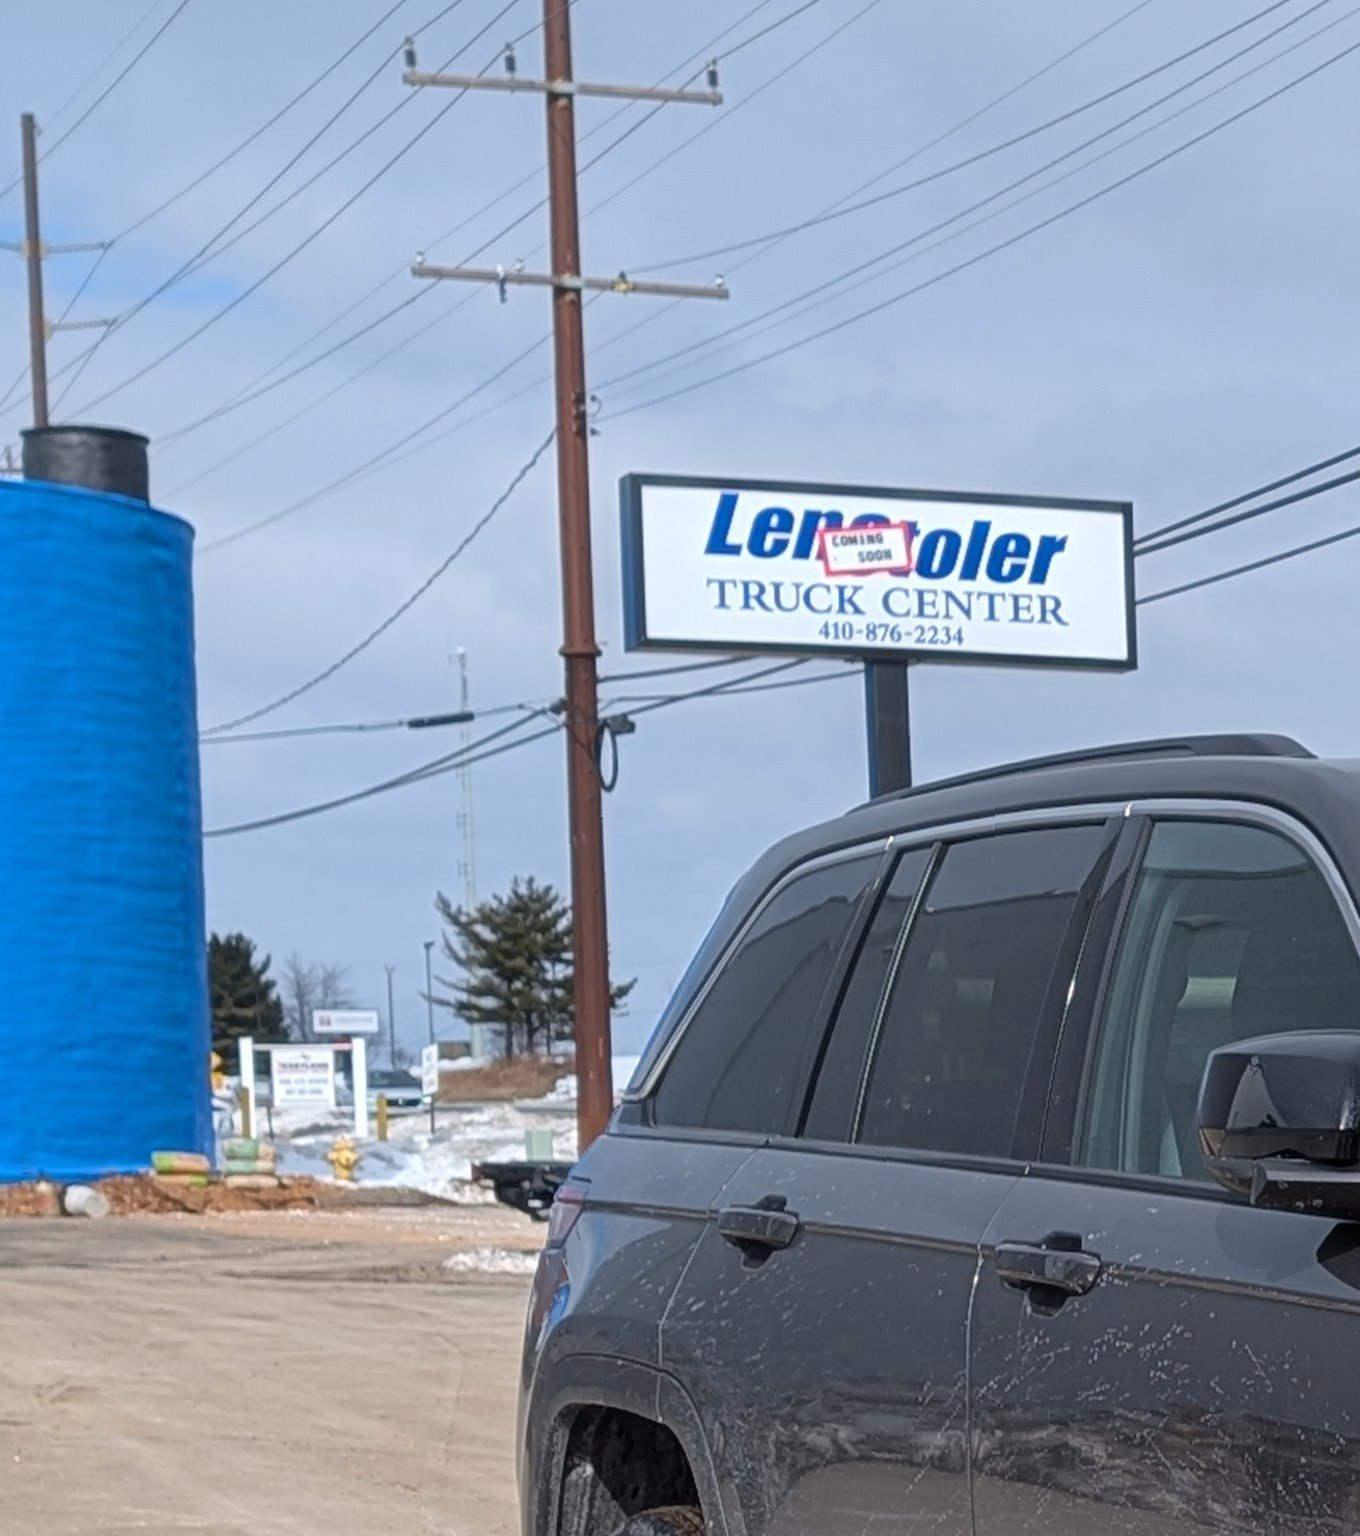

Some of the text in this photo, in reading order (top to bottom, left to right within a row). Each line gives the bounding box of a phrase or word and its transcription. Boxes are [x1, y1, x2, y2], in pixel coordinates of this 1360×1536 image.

[704, 491, 1068, 585] Lenoler
[832, 532, 884, 548] COMING
[857, 548, 893, 563] SOON
[706, 578, 1069, 627] TRUCK CENTER
[818, 622, 965, 647] 410-876-2234
